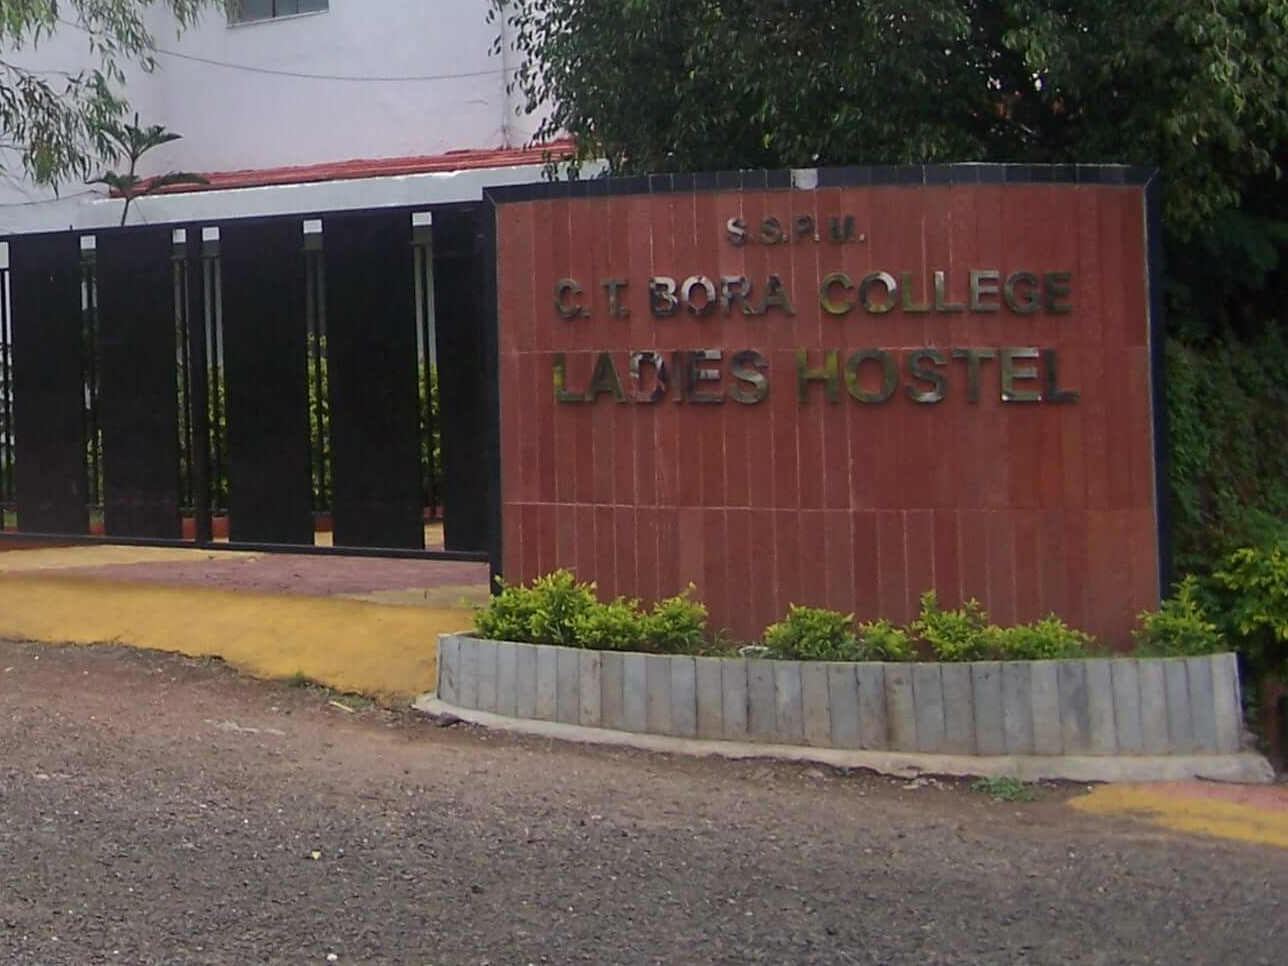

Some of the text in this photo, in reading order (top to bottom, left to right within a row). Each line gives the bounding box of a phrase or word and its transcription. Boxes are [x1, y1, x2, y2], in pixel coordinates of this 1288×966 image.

[648, 273, 795, 318] BORA
[819, 270, 1073, 315] COLLEGE
[552, 346, 1080, 404] LADIES HOSTEL
